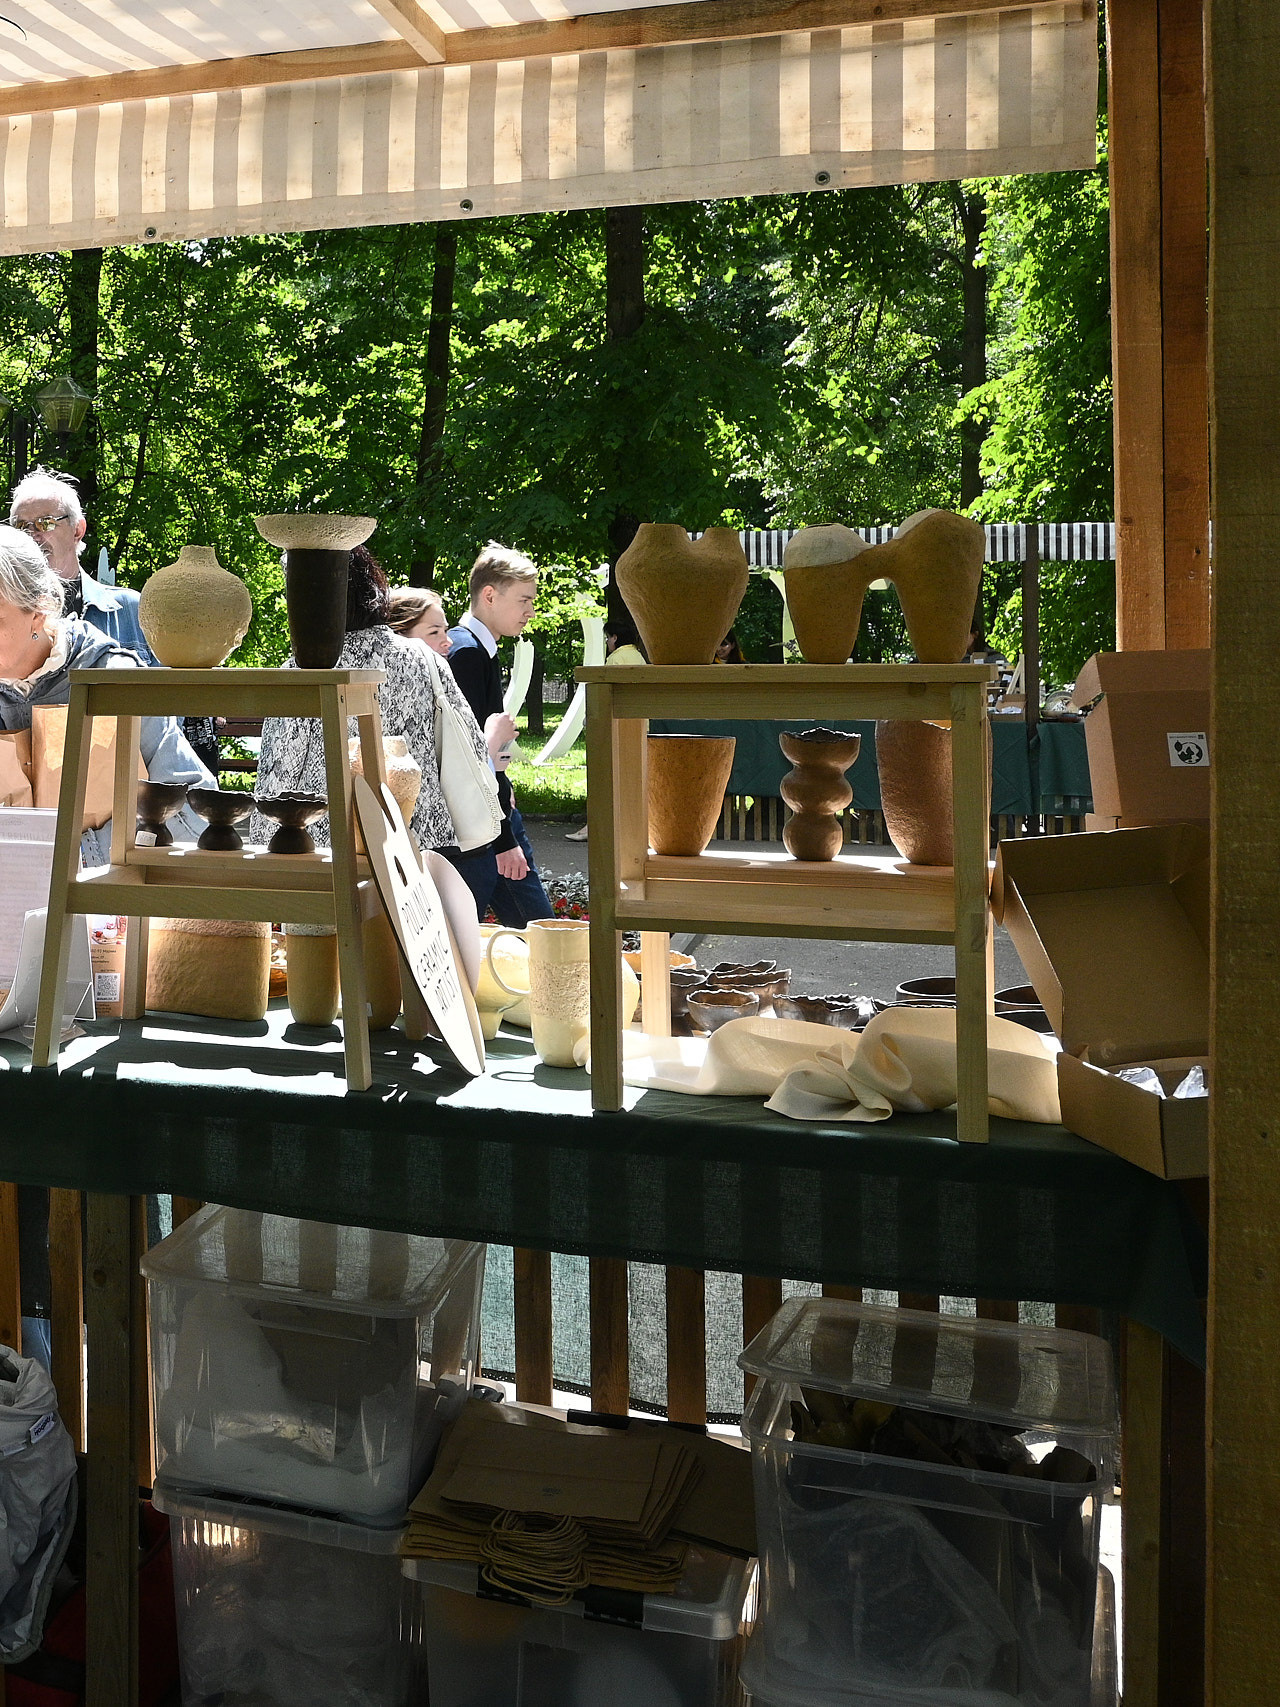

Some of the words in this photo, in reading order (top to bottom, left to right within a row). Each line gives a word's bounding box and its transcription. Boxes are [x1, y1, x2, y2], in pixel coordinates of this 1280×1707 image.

[401, 882, 433, 941] POLINA
[416, 930, 448, 989] CERAMIC
[434, 966, 458, 1017] ARTIST
